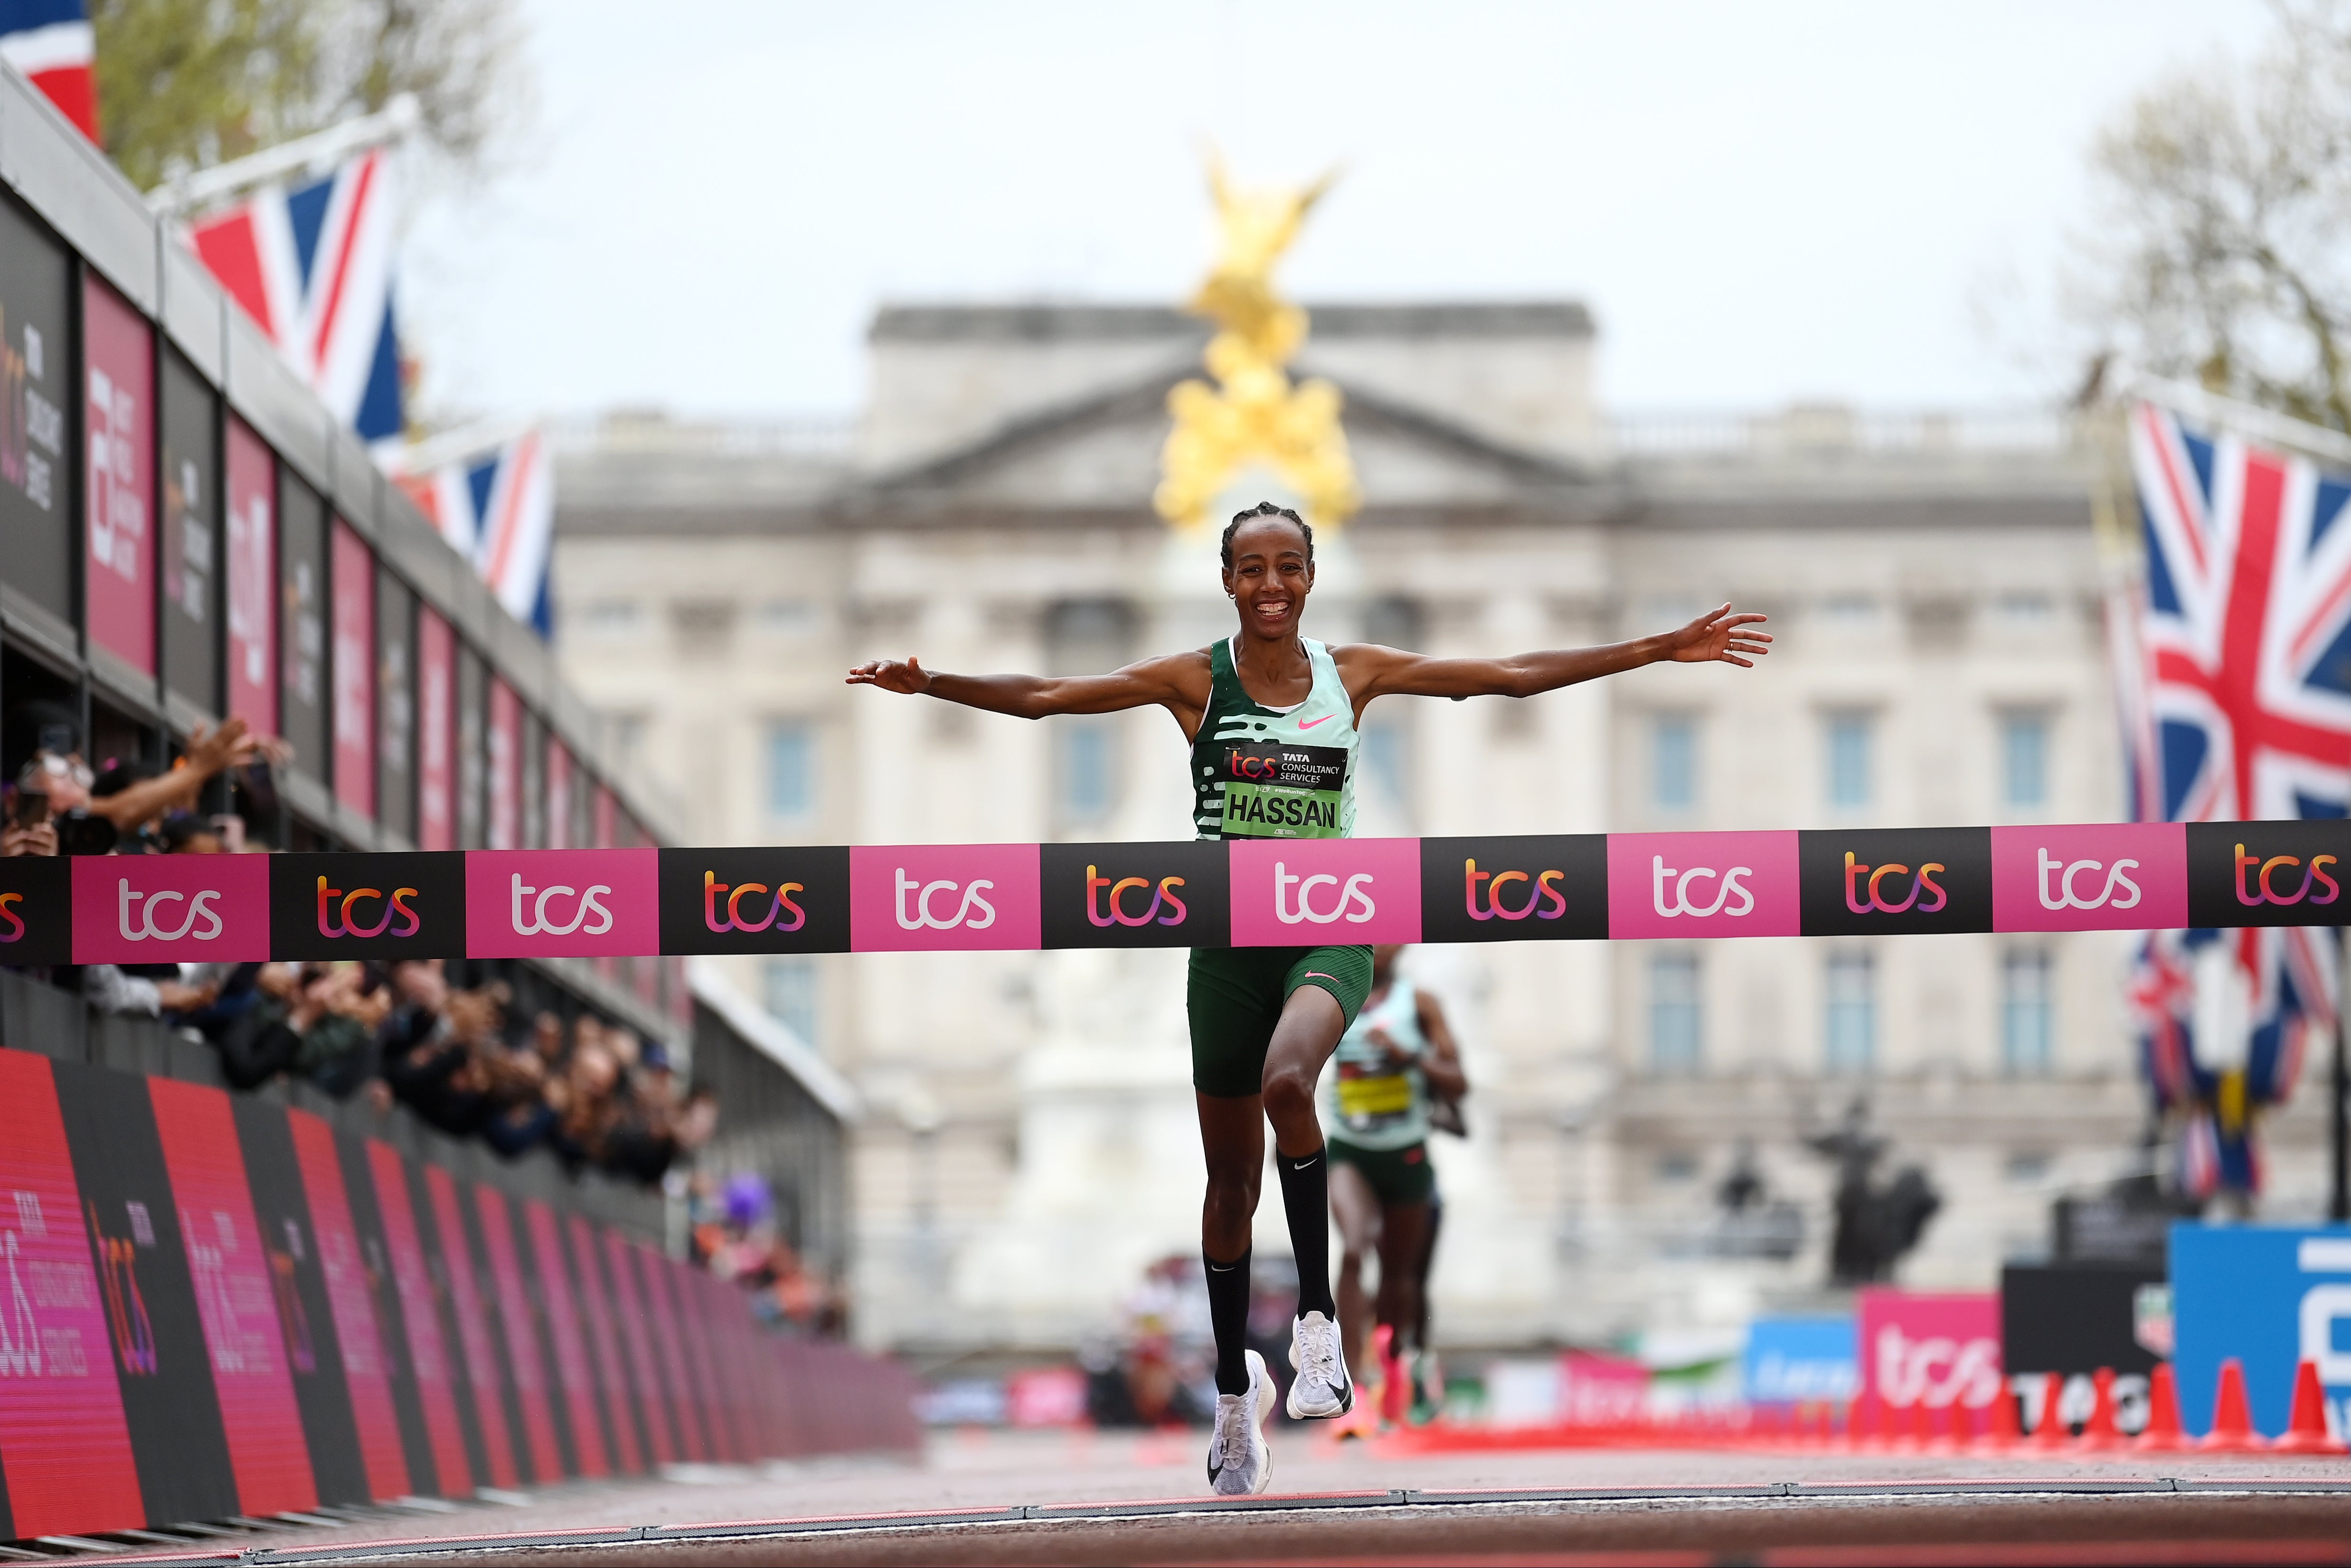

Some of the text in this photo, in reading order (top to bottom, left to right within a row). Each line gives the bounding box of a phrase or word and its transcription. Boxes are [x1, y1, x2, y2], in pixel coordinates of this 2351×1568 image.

[1231, 750, 1276, 778] tcs
[1282, 753, 1310, 763] TATA
[1282, 763, 1340, 775] CONSULTANCY
[1280, 772, 1321, 784] SERVICES
[1228, 793, 1335, 829] HASSAN
[119, 843, 2340, 941] tcs tcs tcs tcs tcs tcs tcs tcs tcs tcs tcs tcs
[1876, 1324, 2001, 1409] tcs
